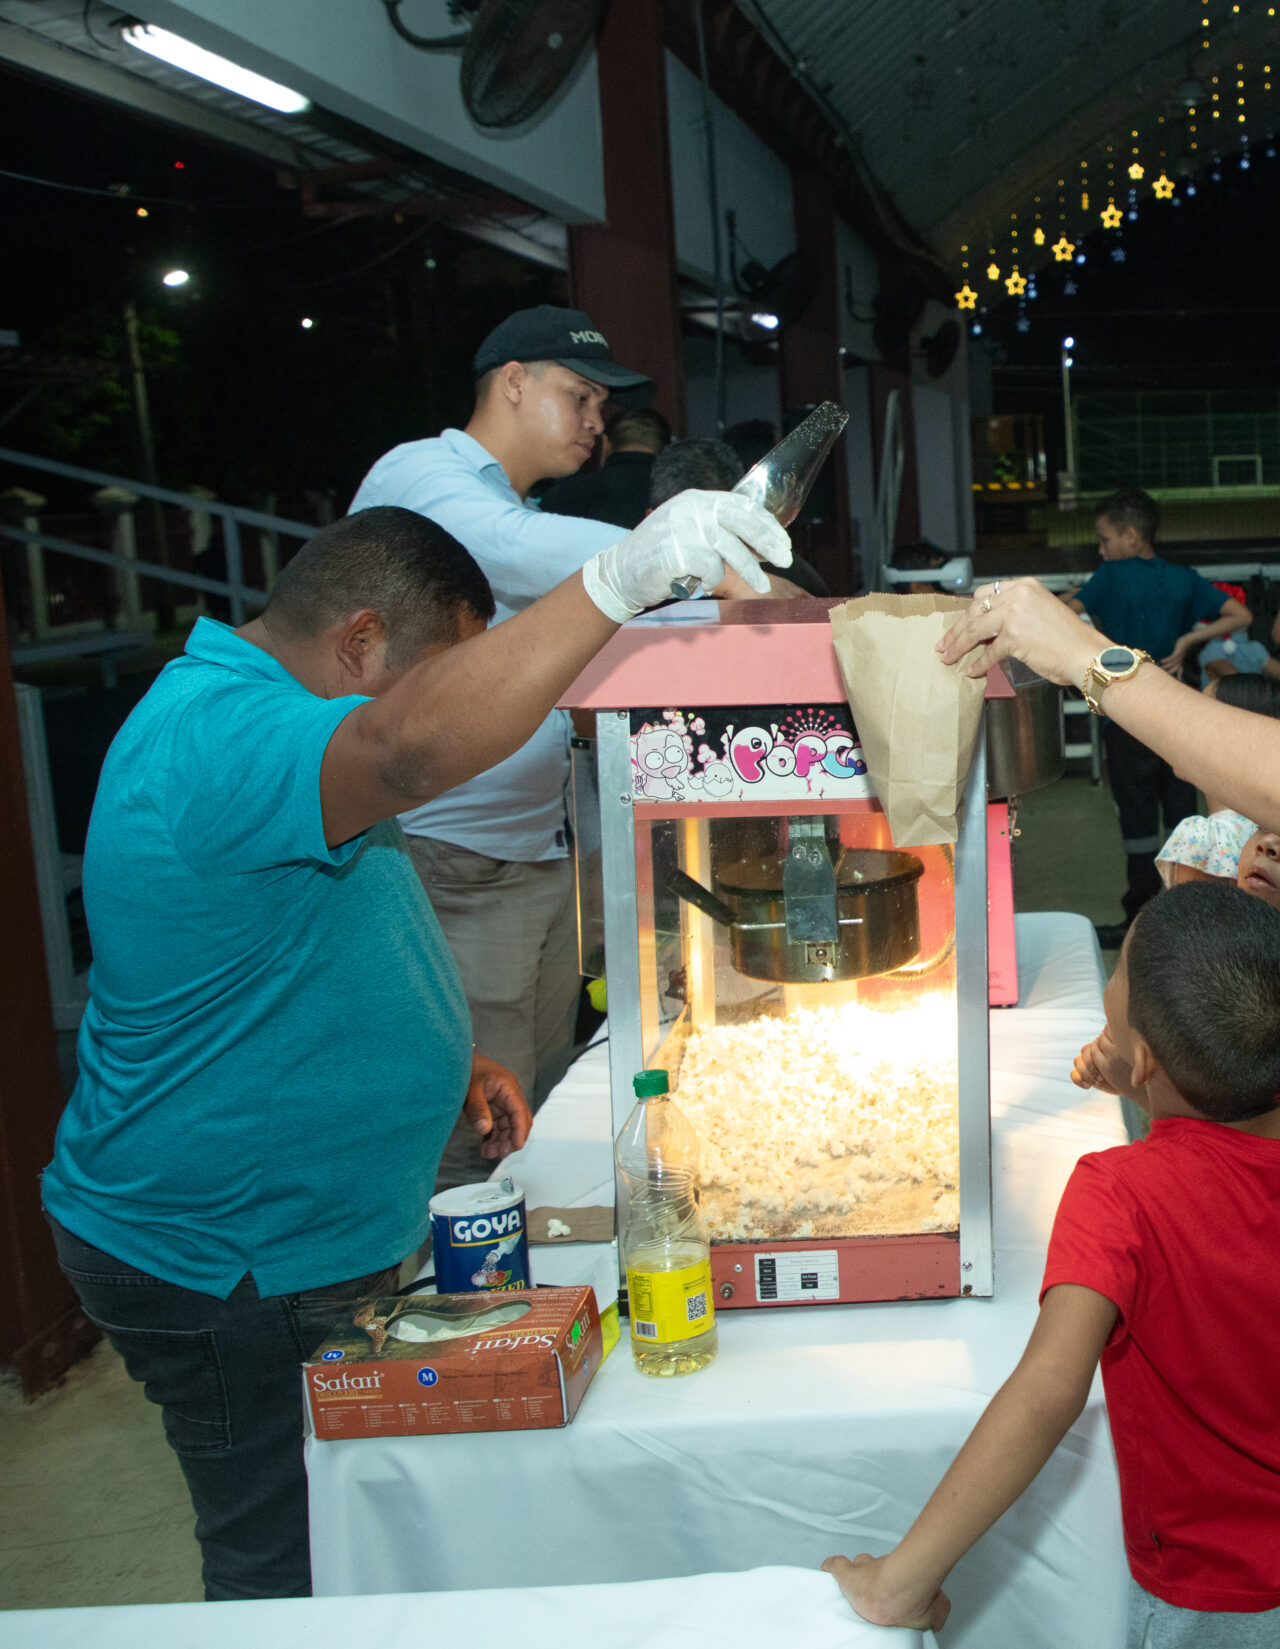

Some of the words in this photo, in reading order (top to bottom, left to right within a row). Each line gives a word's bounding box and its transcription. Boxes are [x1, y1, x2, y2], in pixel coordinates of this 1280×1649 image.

[453, 1209, 522, 1243] GOYA
[472, 1333, 557, 1354] Safari
[313, 1370, 381, 1393] Safari
